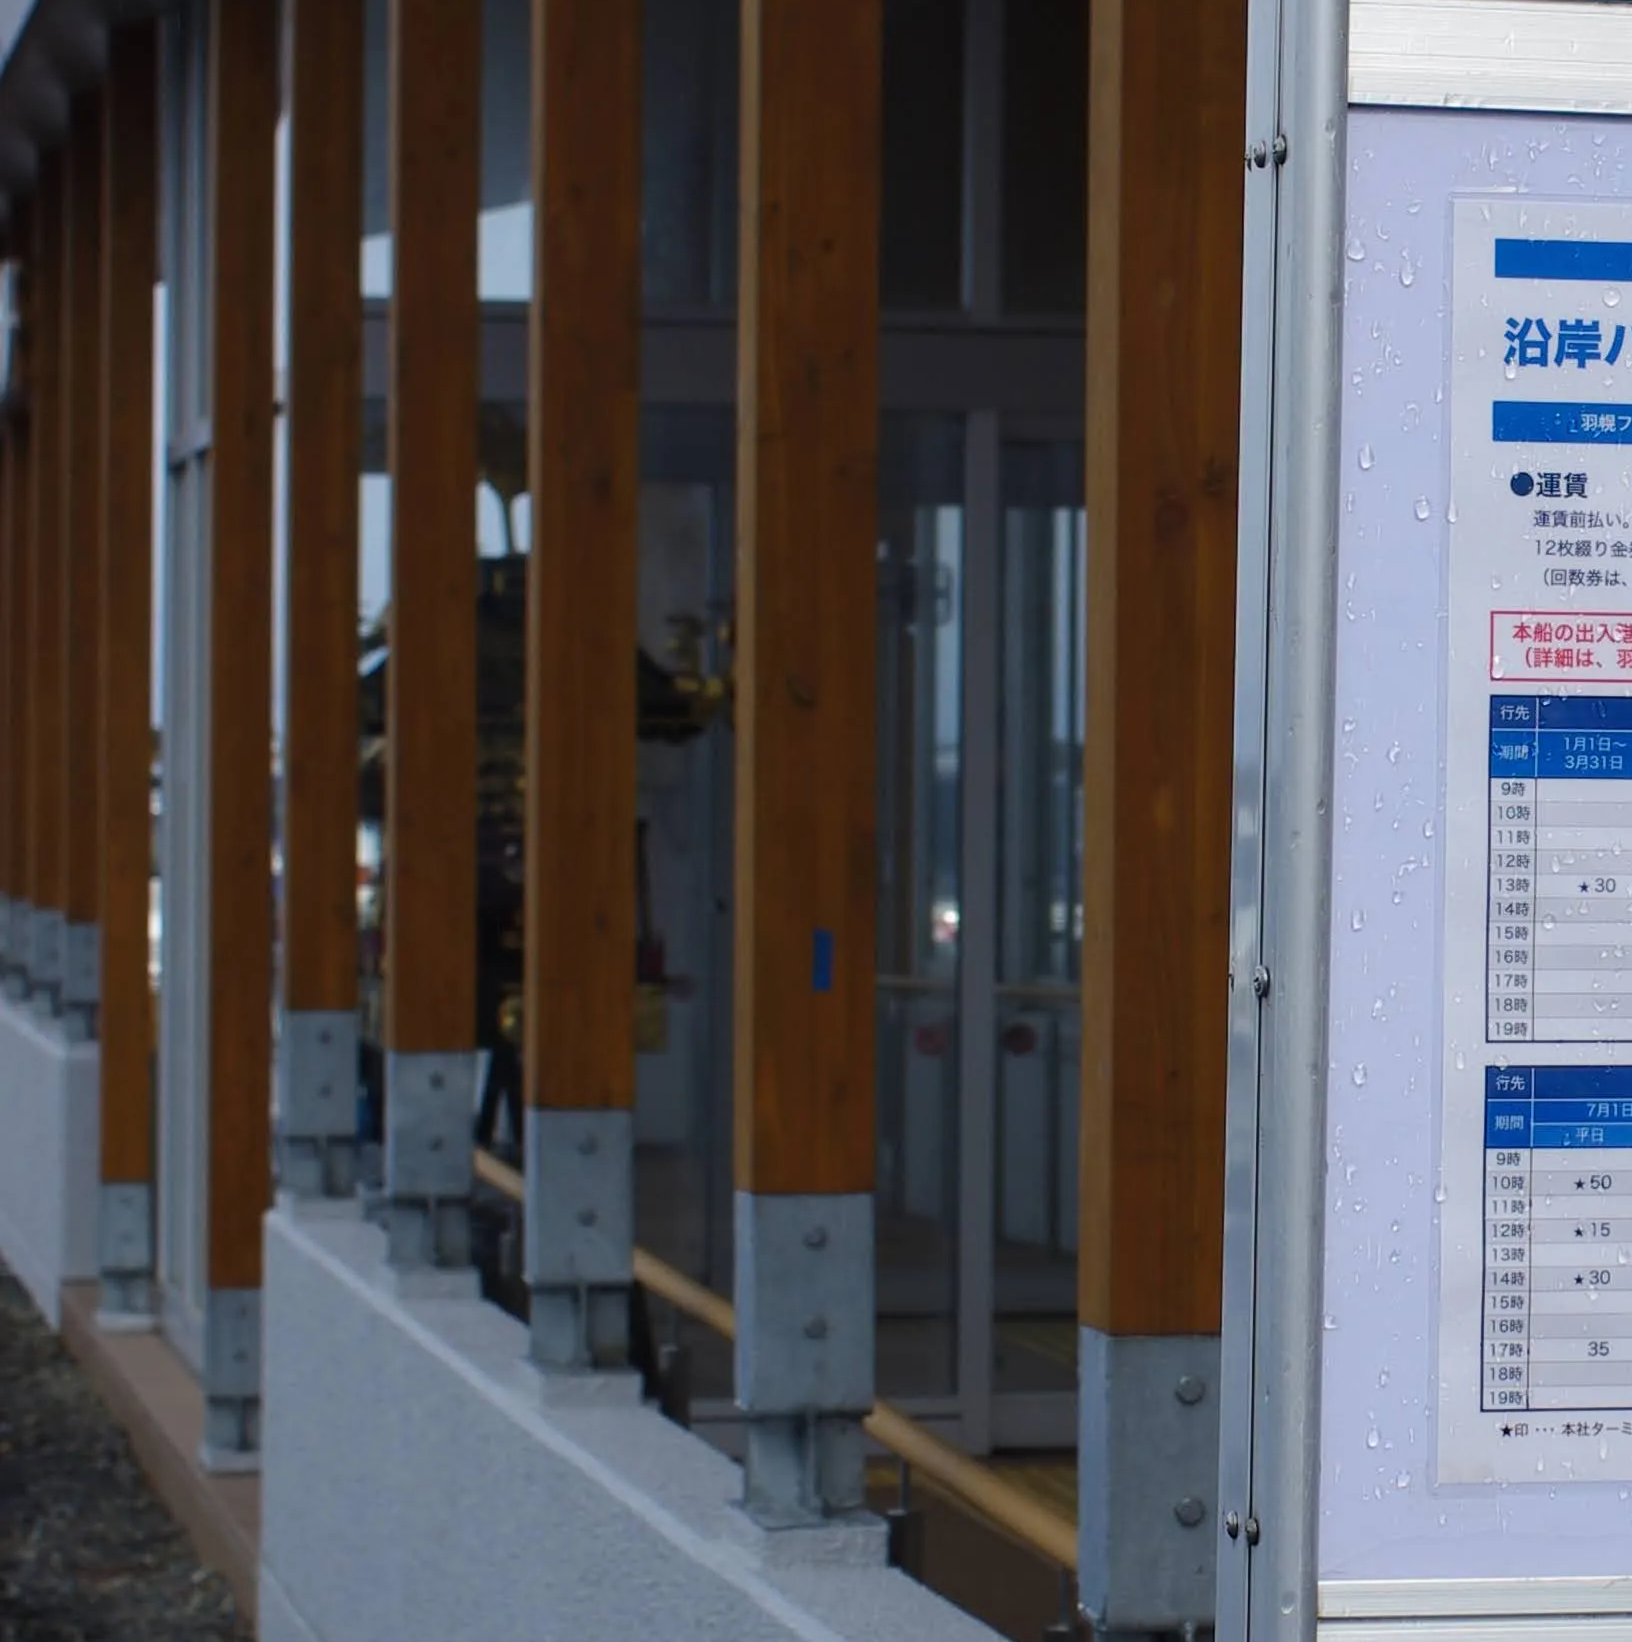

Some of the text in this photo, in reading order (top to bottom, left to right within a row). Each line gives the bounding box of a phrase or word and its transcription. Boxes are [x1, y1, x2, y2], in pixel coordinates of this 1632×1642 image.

[1500, 705, 1530, 721] 行先
[1499, 744, 1529, 759] 期間
[1565, 755, 1624, 770] 3月31日
[1501, 782, 1526, 796] 9時
[1497, 806, 1530, 821] 10時
[1497, 830, 1530, 845] 11時
[1497, 855, 1530, 869] 12時
[1496, 878, 1529, 893] 13時
[1594, 879, 1616, 893] 30
[1496, 902, 1529, 916] 14時
[1495, 926, 1528, 940] 15時
[1495, 949, 1528, 964] 16時
[1494, 974, 1528, 988] 17時
[1494, 998, 1528, 1012] 18時
[1494, 1021, 1528, 1036] 19時
[1496, 1075, 1525, 1091] 行先
[1494, 1115, 1524, 1130] 期間
[1576, 1127, 1604, 1143] 平日
[1496, 1152, 1521, 1166] 9時
[1492, 1176, 1525, 1190] 10時
[1591, 1175, 1612, 1189] 50
[1492, 1199, 1525, 1215] 11時
[1492, 1223, 1525, 1238] 12時
[1592, 1223, 1610, 1237] 15
[1492, 1248, 1525, 1263] 13時
[1491, 1271, 1525, 1286] 14時
[1589, 1271, 1611, 1286] 30
[1491, 1295, 1524, 1309] 15時
[1491, 1319, 1524, 1334] 16時
[1490, 1343, 1523, 1358] 17時
[1588, 1342, 1609, 1357] 35
[1490, 1366, 1522, 1381] 18時
[1489, 1390, 1522, 1406] 19時
